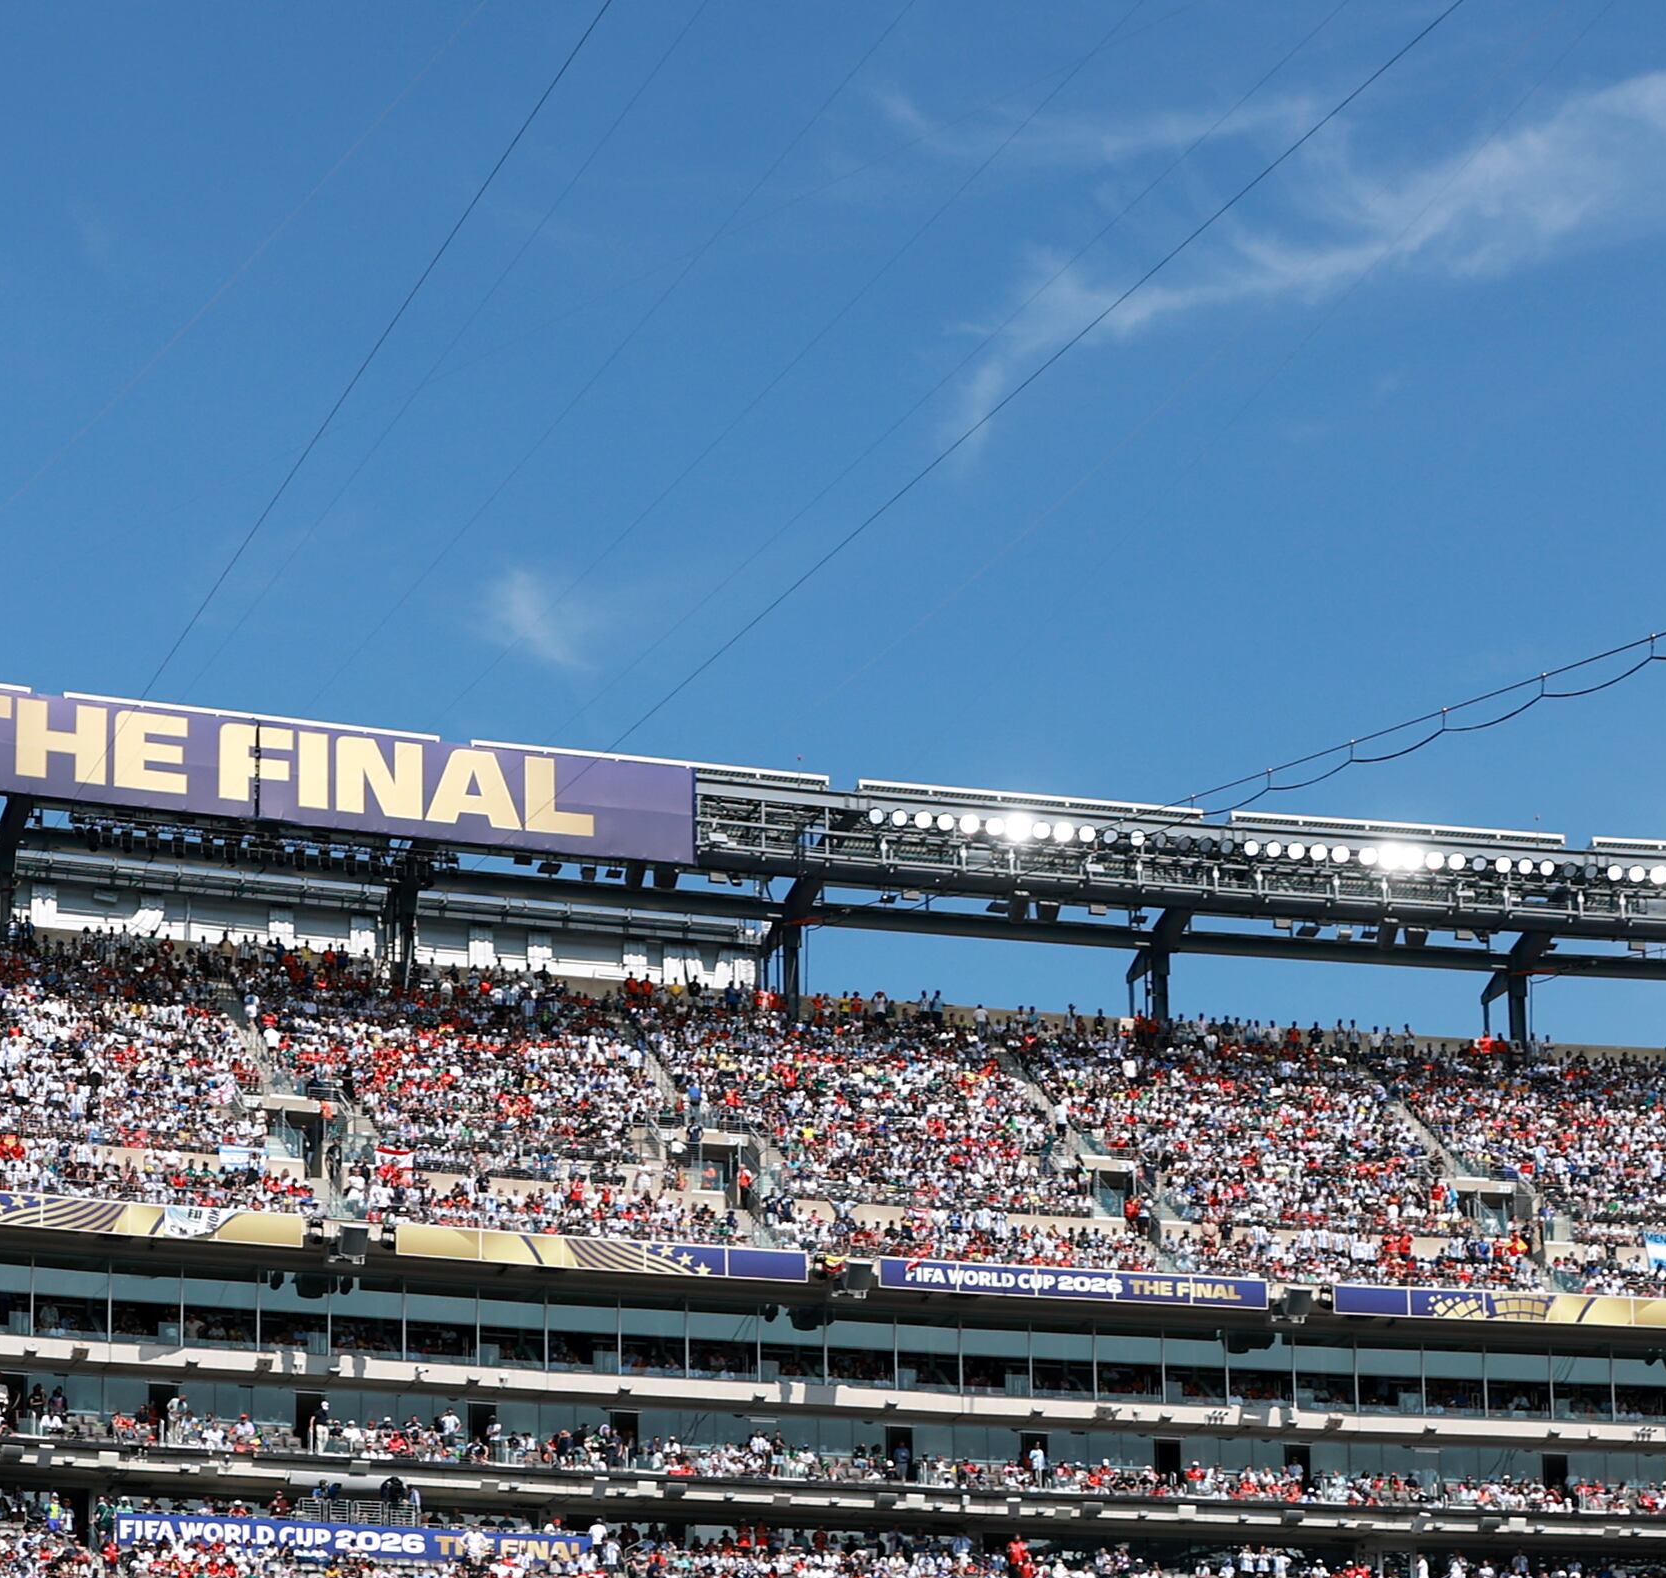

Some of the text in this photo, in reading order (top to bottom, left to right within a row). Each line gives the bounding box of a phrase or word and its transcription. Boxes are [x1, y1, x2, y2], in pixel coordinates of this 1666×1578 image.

[218, 721, 595, 837] FINAL
[905, 1268, 1242, 1300] FIFA WORLD CUP 2026 THE FINAL
[119, 1519, 177, 1544] FIFA
[179, 1522, 275, 1547] WORLD
[280, 1527, 331, 1549] CUP
[334, 1531, 426, 1554] 2026
